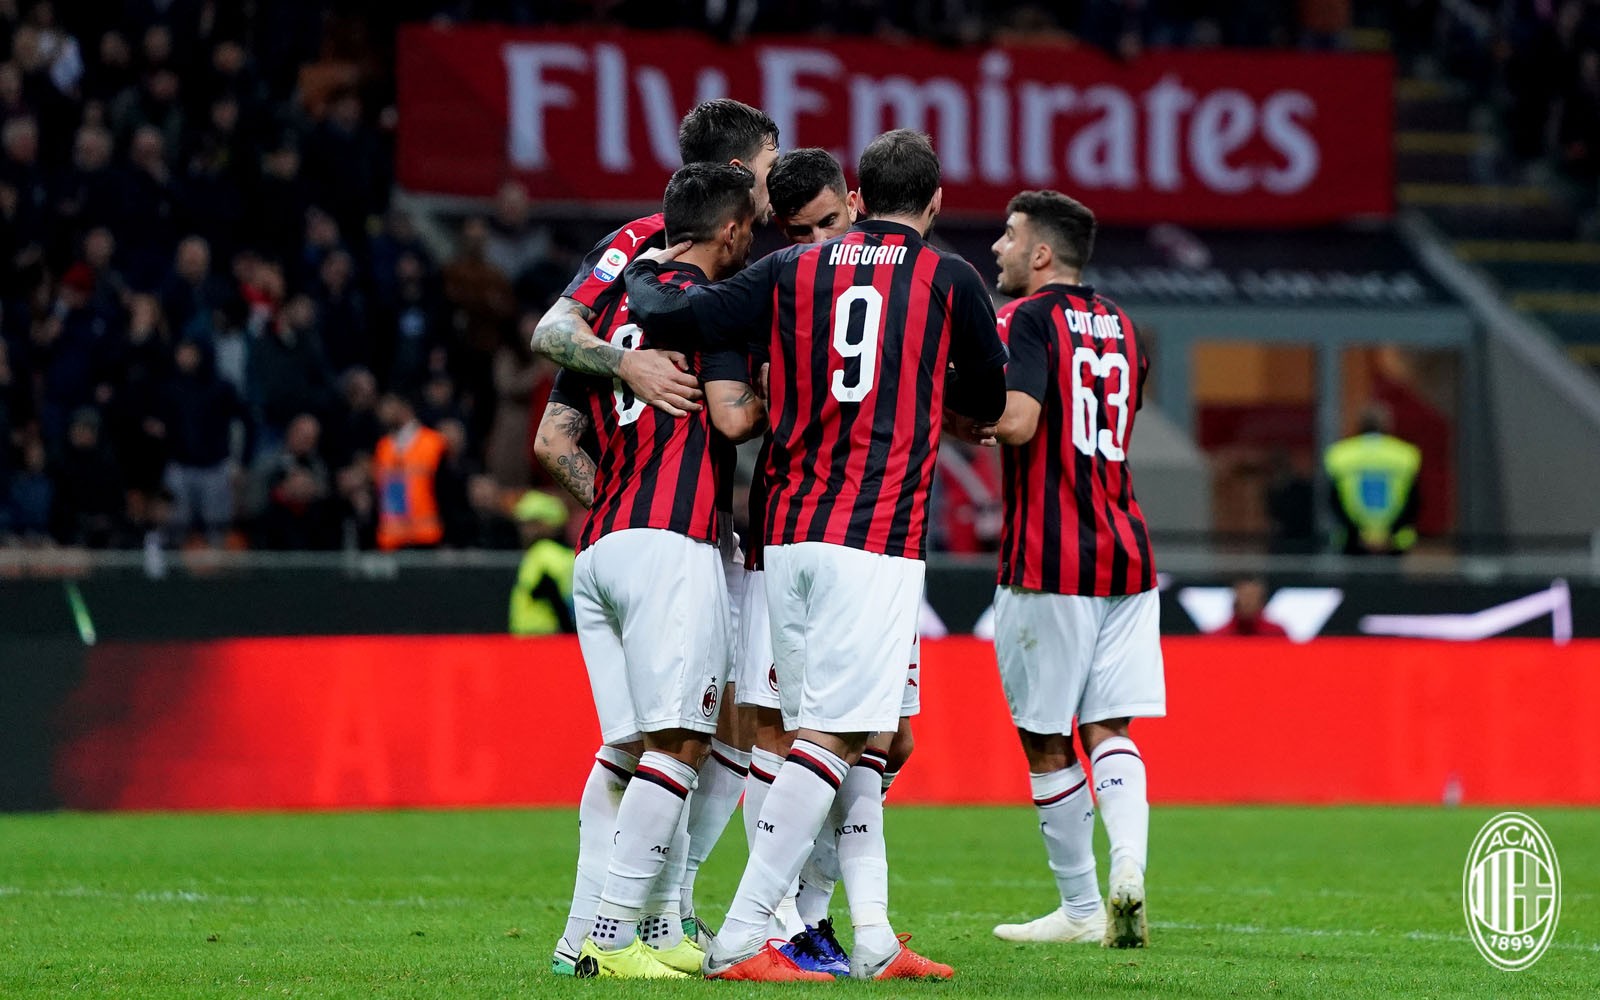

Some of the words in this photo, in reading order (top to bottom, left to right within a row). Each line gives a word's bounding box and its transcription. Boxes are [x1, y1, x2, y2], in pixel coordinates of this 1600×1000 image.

[757, 46, 1319, 194] Emirates
[829, 244, 908, 266] HIGUAIN
[831, 285, 883, 402] 9
[1072, 347, 1130, 461] 63
[756, 819, 775, 833] CM
